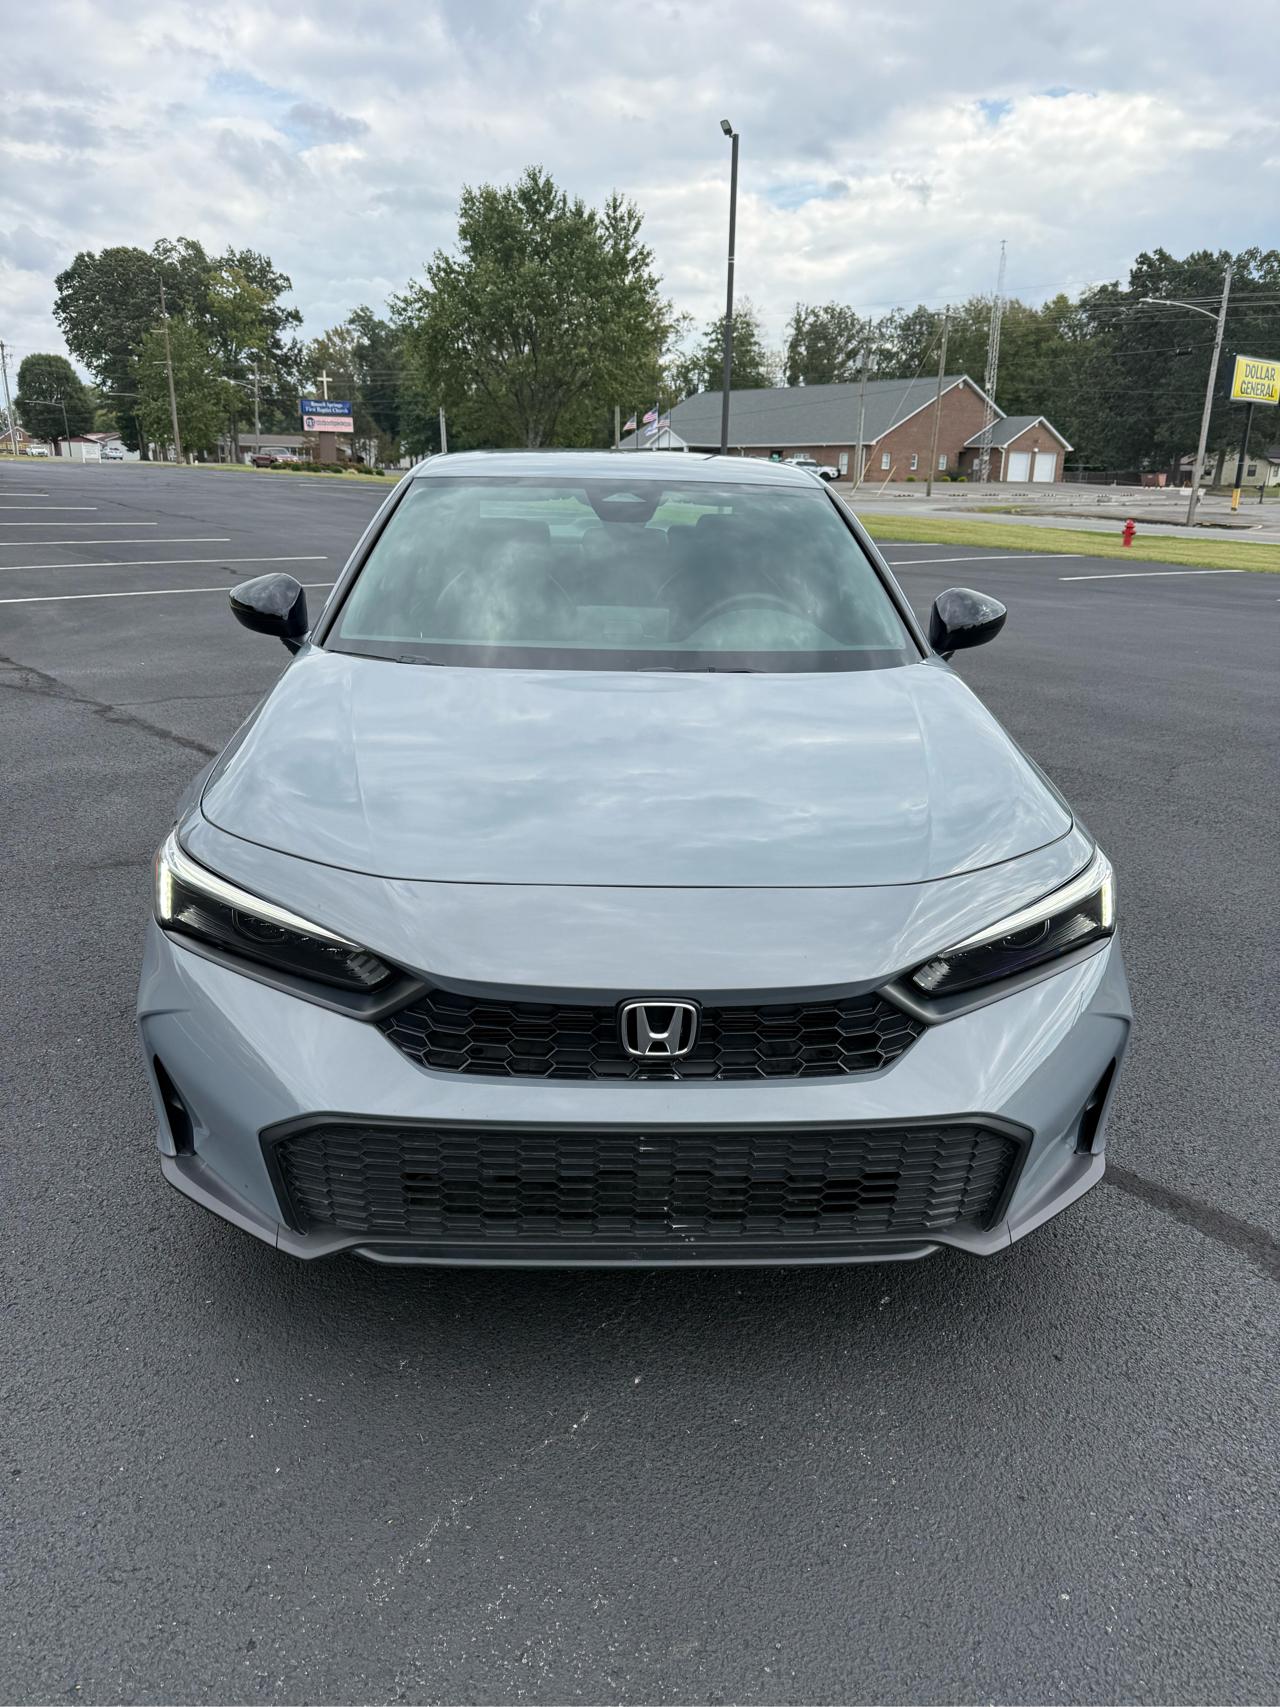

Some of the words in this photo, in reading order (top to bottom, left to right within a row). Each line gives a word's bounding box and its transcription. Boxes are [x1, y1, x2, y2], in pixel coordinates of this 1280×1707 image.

[1245, 363, 1276, 381] DOLLAR
[1240, 380, 1275, 398] GENERAL
[635, 1005, 685, 1056] H
